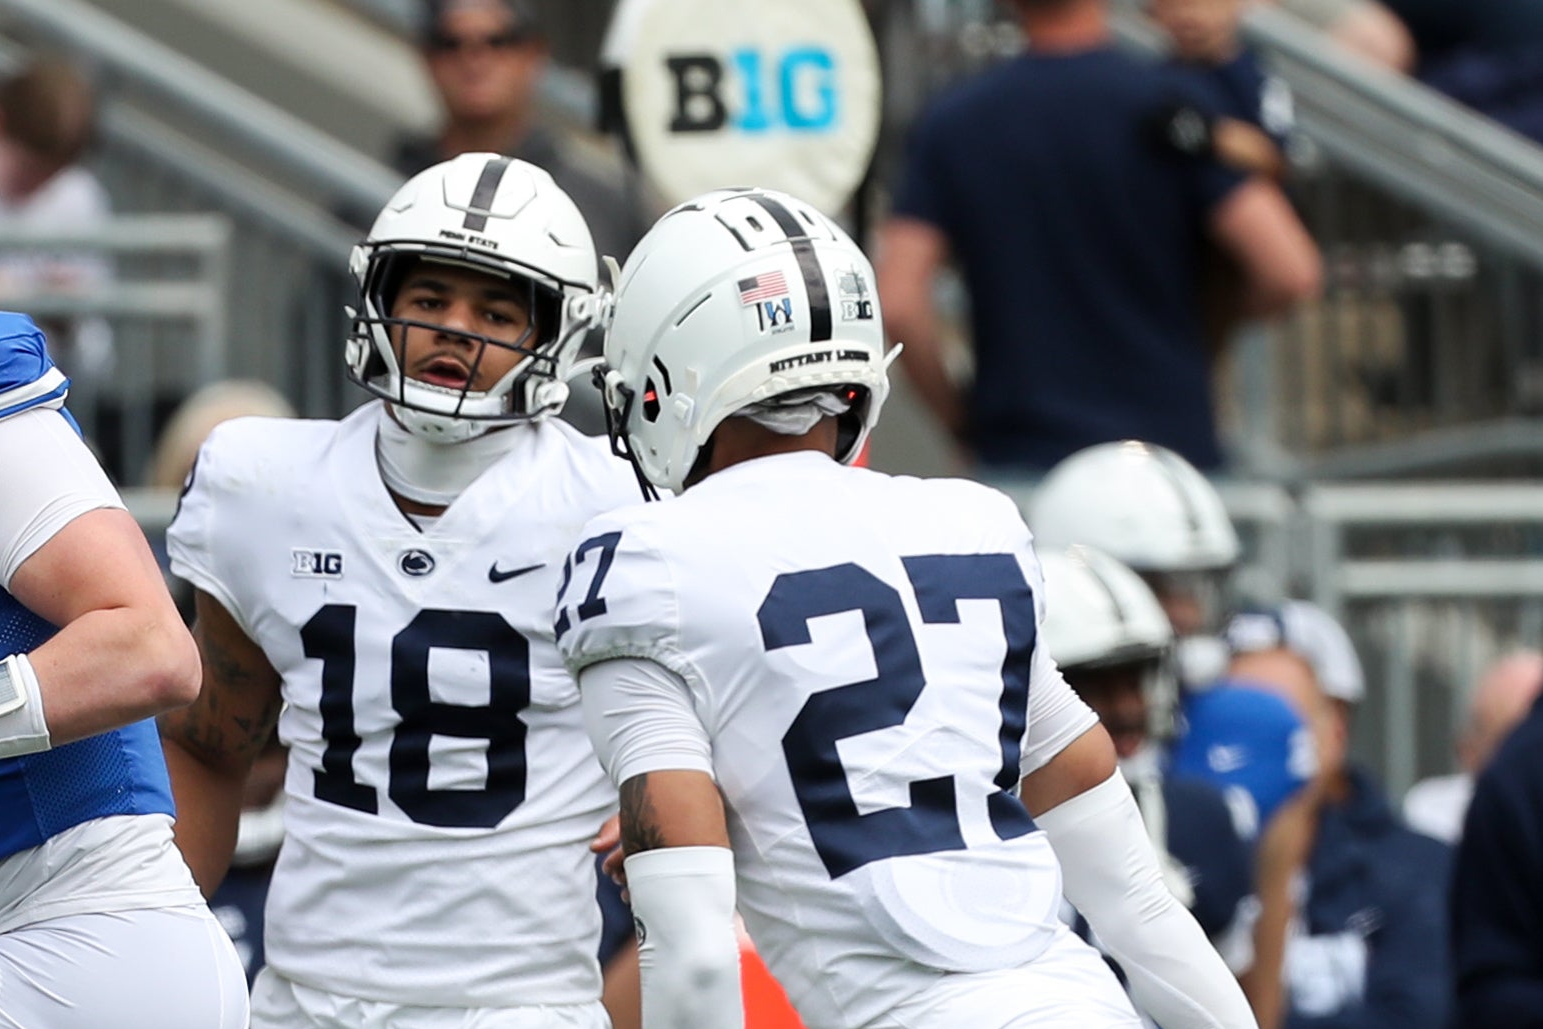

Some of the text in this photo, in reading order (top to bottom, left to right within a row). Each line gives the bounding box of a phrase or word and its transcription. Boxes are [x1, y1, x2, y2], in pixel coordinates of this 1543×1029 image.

[768, 350, 833, 374] NITTANY
[300, 604, 530, 828] 18
[756, 553, 1039, 881] 27
